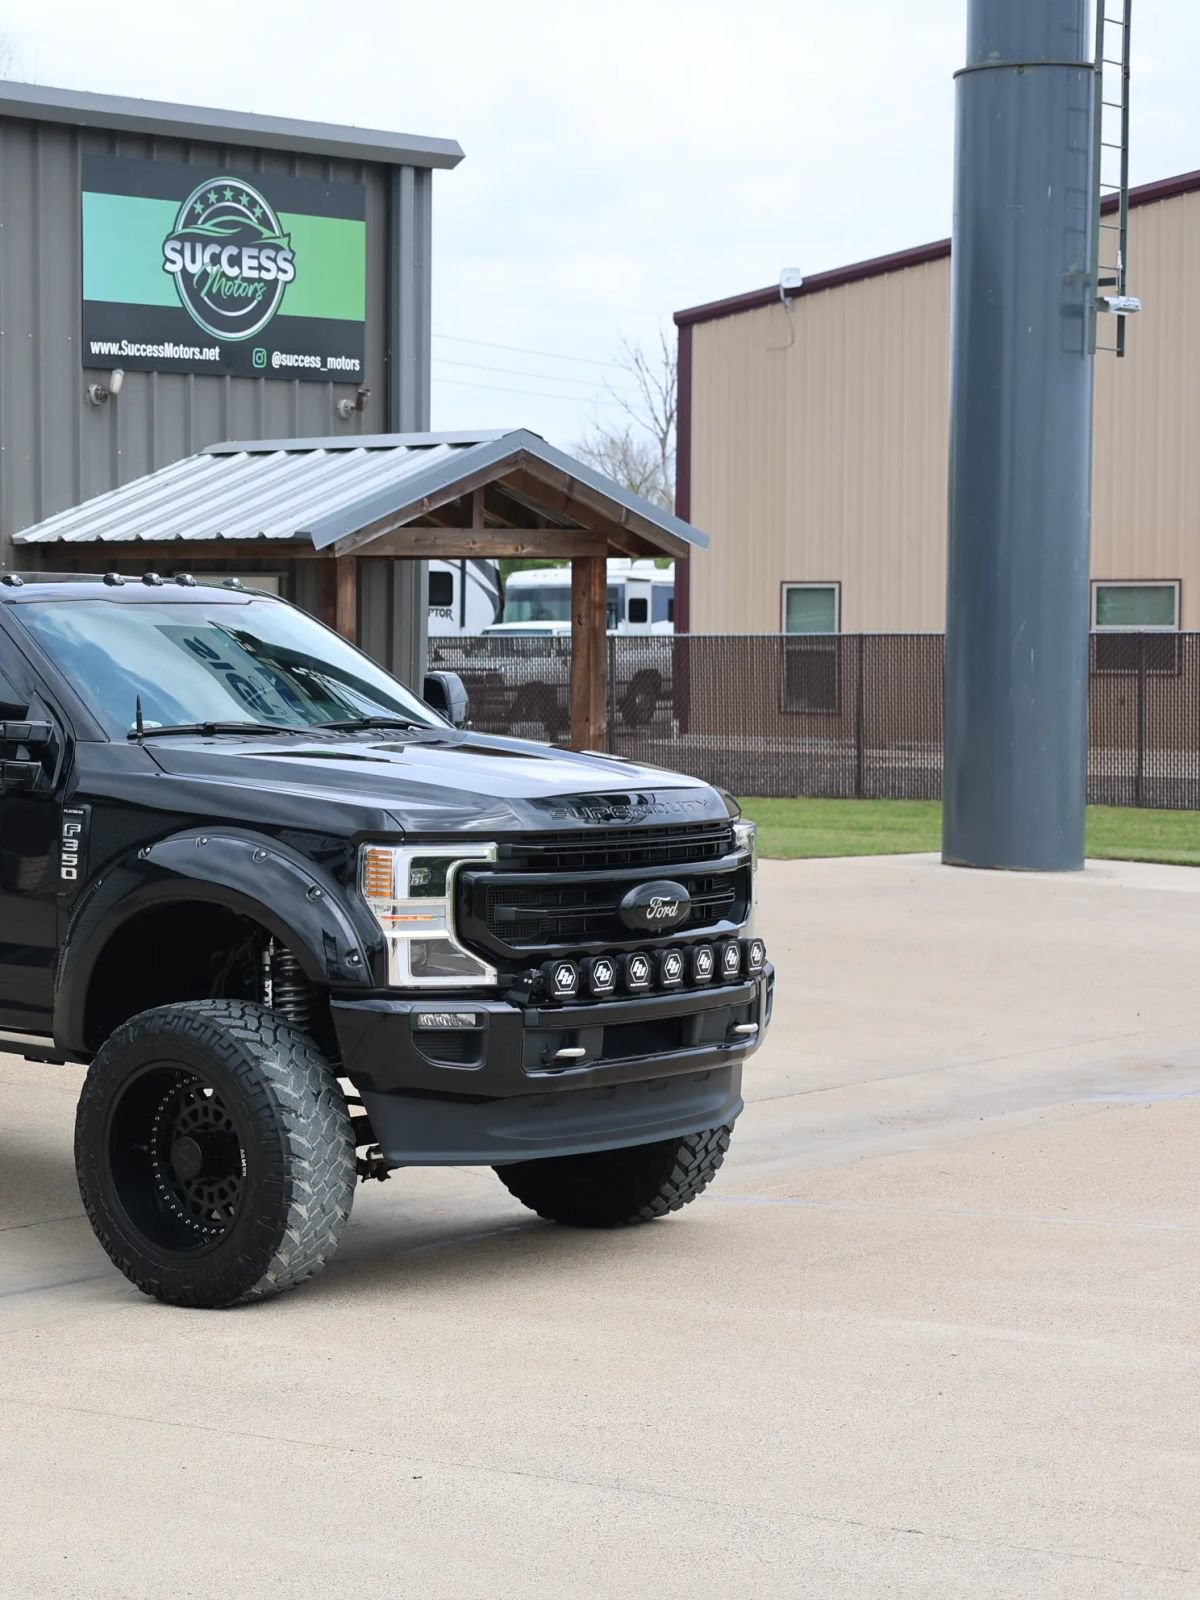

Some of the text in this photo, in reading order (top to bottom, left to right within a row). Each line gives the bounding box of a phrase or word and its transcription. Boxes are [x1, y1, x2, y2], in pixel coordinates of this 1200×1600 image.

[164, 240, 295, 281] SUCCESS
[193, 261, 267, 300] Motors
[90, 340, 220, 360] www.SuccessMotors.net
[272, 351, 360, 371] @success_motors
[550, 804, 650, 821] SUPER
[646, 896, 679, 919] Ford
